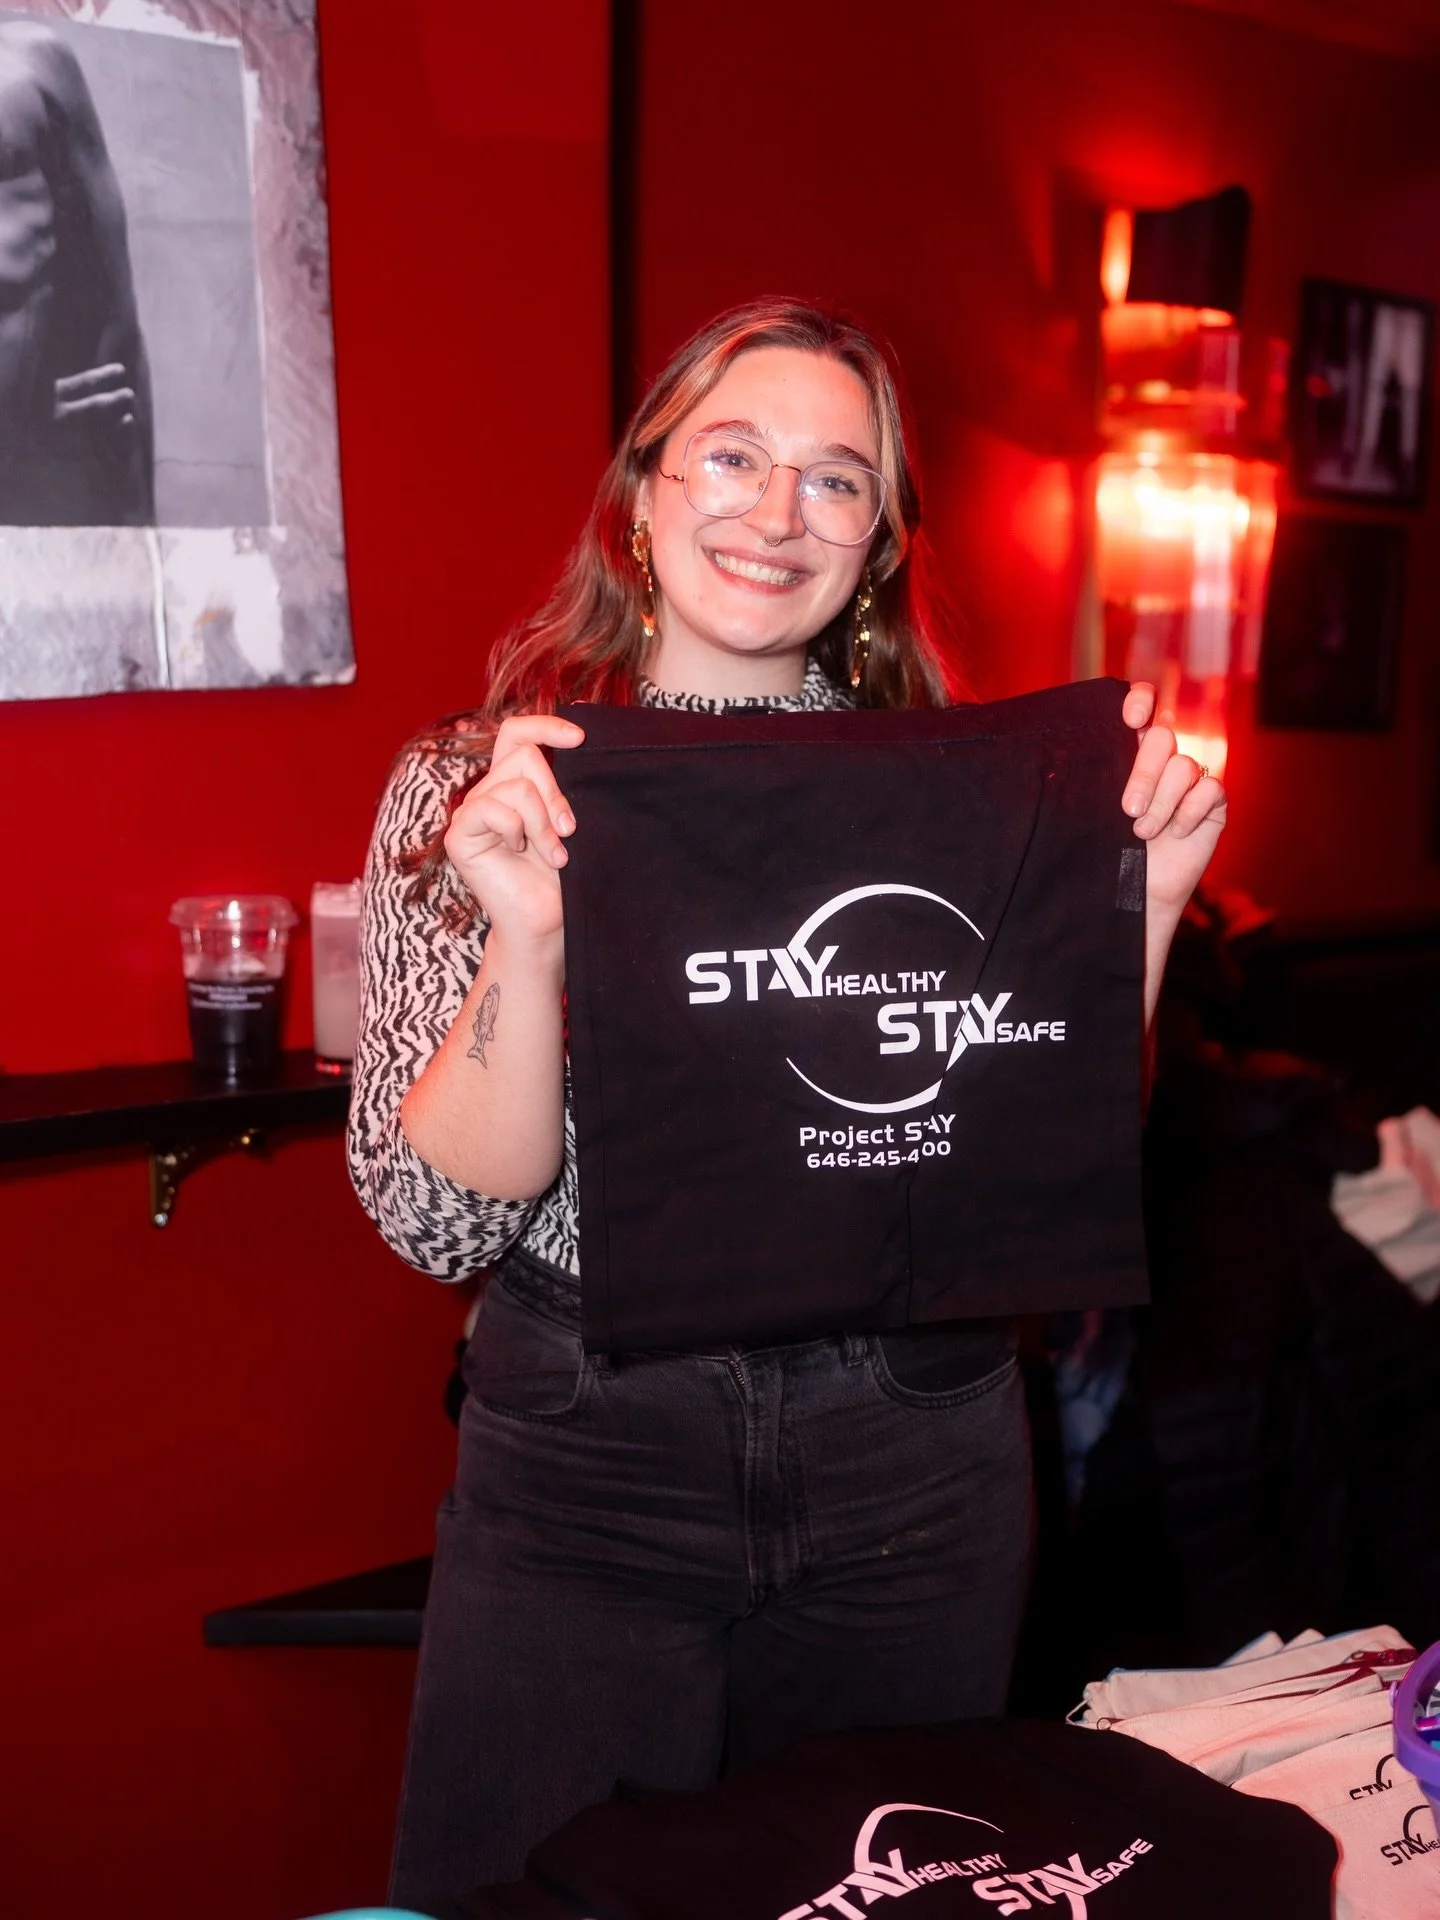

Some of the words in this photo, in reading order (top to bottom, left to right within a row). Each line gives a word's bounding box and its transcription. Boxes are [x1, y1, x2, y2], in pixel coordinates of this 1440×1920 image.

[684, 945, 840, 1005] STAY
[825, 970, 947, 996] HEALTHY
[877, 992, 1013, 1055] STAY
[996, 1021, 1066, 1043] SAFE
[799, 1123, 895, 1150] Project
[907, 1853, 1009, 1886] HEALTHY
[1380, 1833, 1430, 1867] STAY
[972, 1852, 1103, 1917] STAY
[1091, 1837, 1155, 1885] SAFE
